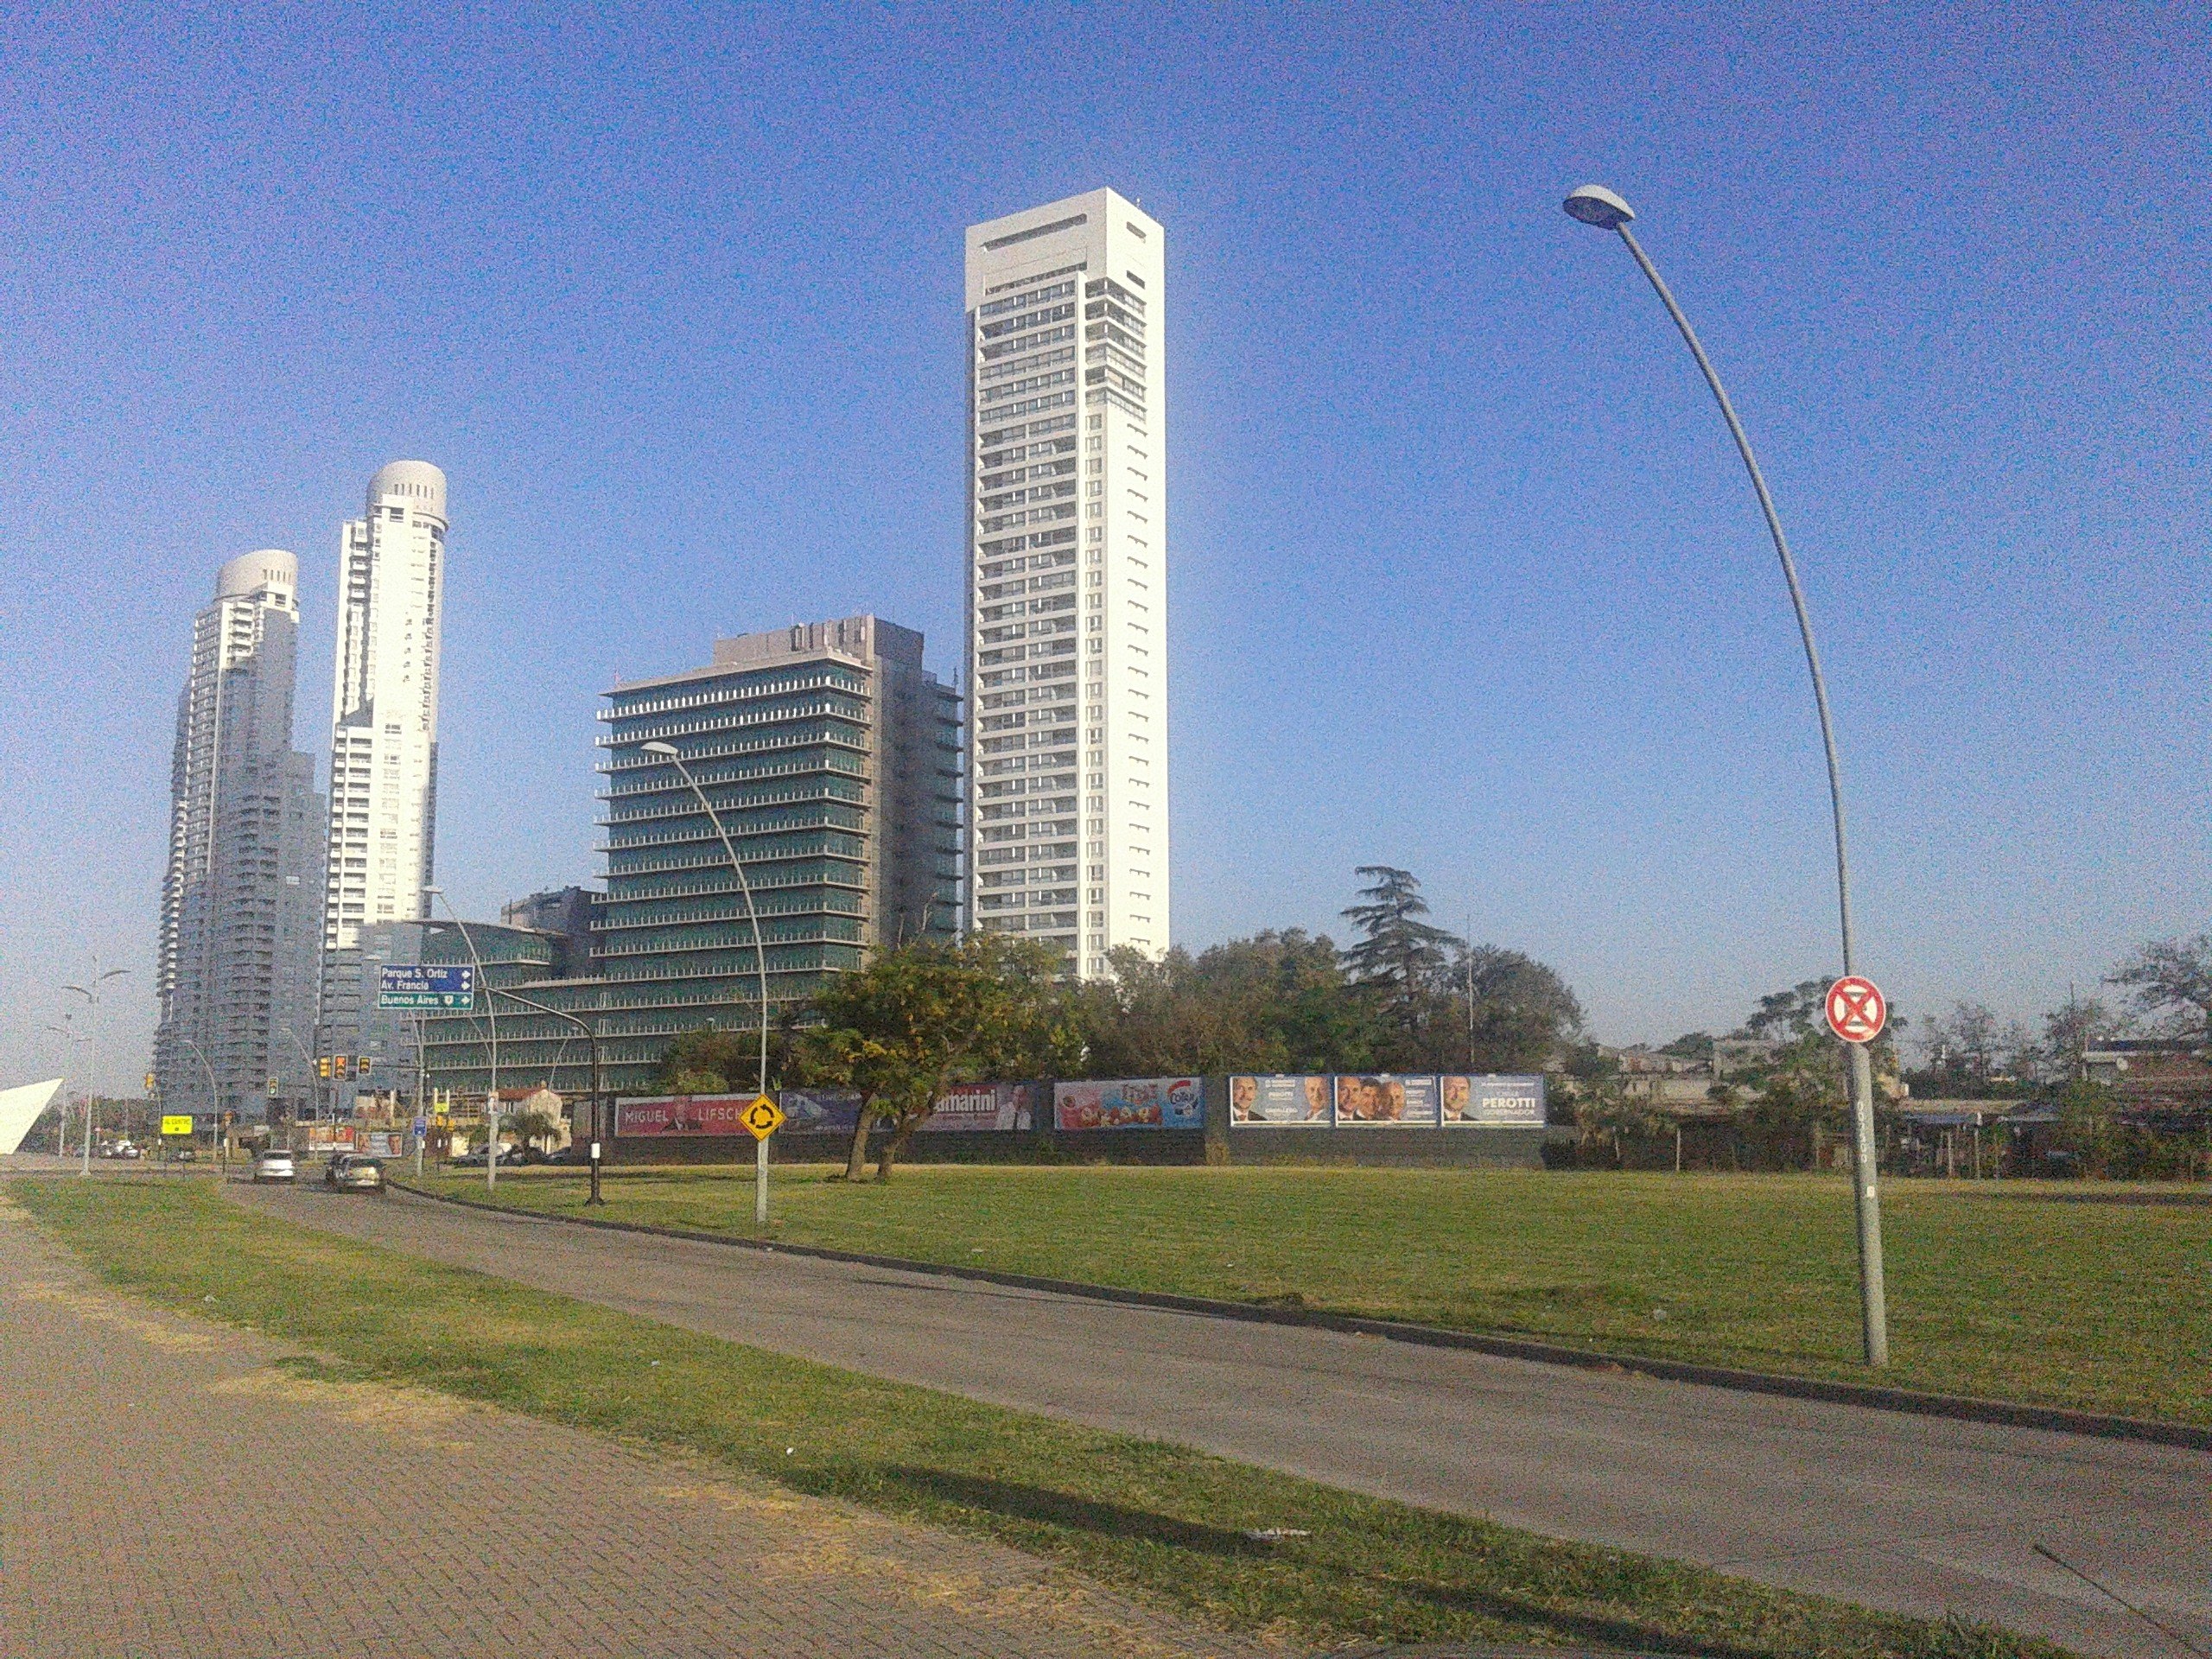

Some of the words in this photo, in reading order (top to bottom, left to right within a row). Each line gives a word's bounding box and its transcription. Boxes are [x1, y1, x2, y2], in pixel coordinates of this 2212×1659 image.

[382, 968, 412, 979] Parque
[415, 968, 424, 978] S.
[427, 969, 448, 979] Ortiz
[381, 981, 394, 989] Av.
[397, 981, 429, 990] Francia
[381, 995, 415, 1005] Buenos
[416, 995, 439, 1005] Aires
[1482, 1097, 1536, 1109] PEROTTI
[625, 1109, 669, 1124] MIGUEL
[698, 1107, 743, 1122] LIFSCH
